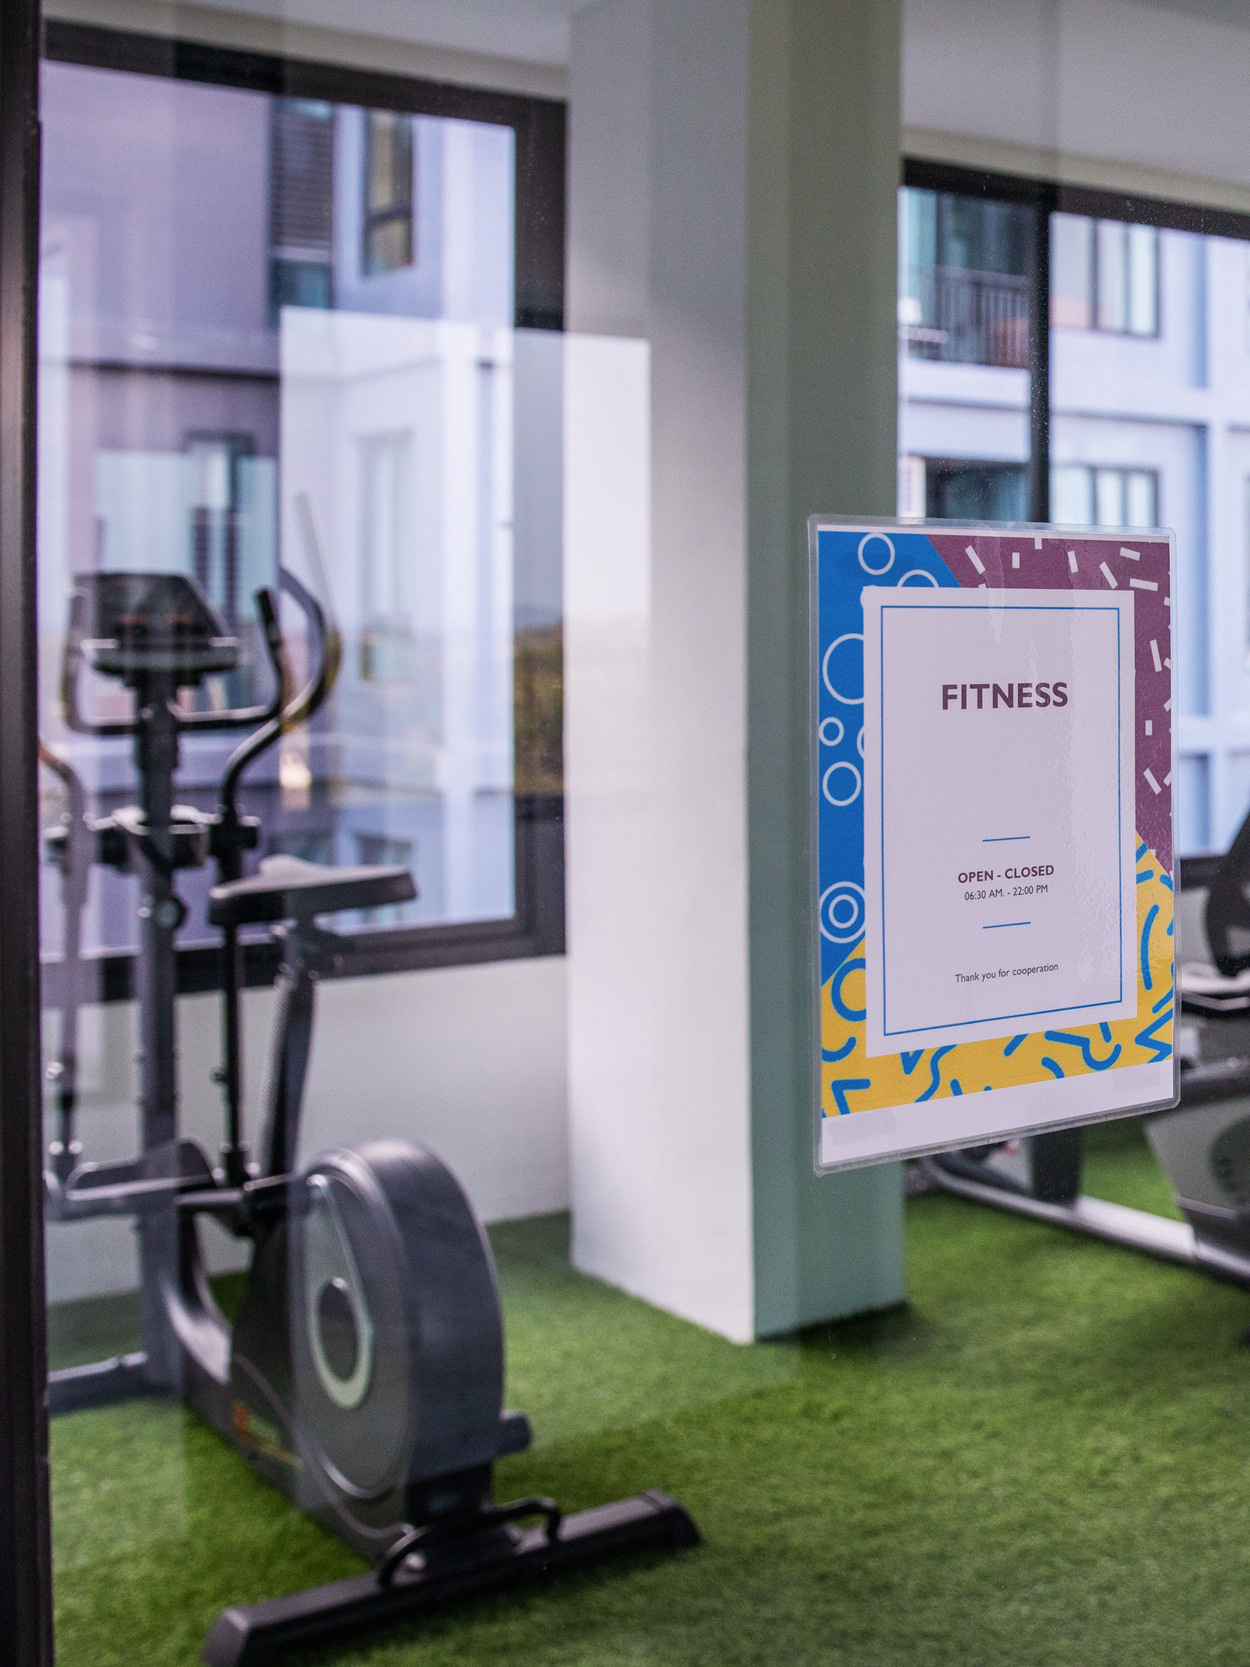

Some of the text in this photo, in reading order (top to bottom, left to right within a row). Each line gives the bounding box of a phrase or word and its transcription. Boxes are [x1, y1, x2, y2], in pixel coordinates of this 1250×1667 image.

[941, 681, 1069, 710] FITNESS
[957, 870, 994, 883] OPEN
[1004, 865, 1055, 879] CLOSED
[964, 889, 987, 901] 06:30
[1012, 885, 1034, 897] 22:00
[1035, 884, 1049, 894] PM
[955, 963, 1059, 983] Thank you for cooperation
